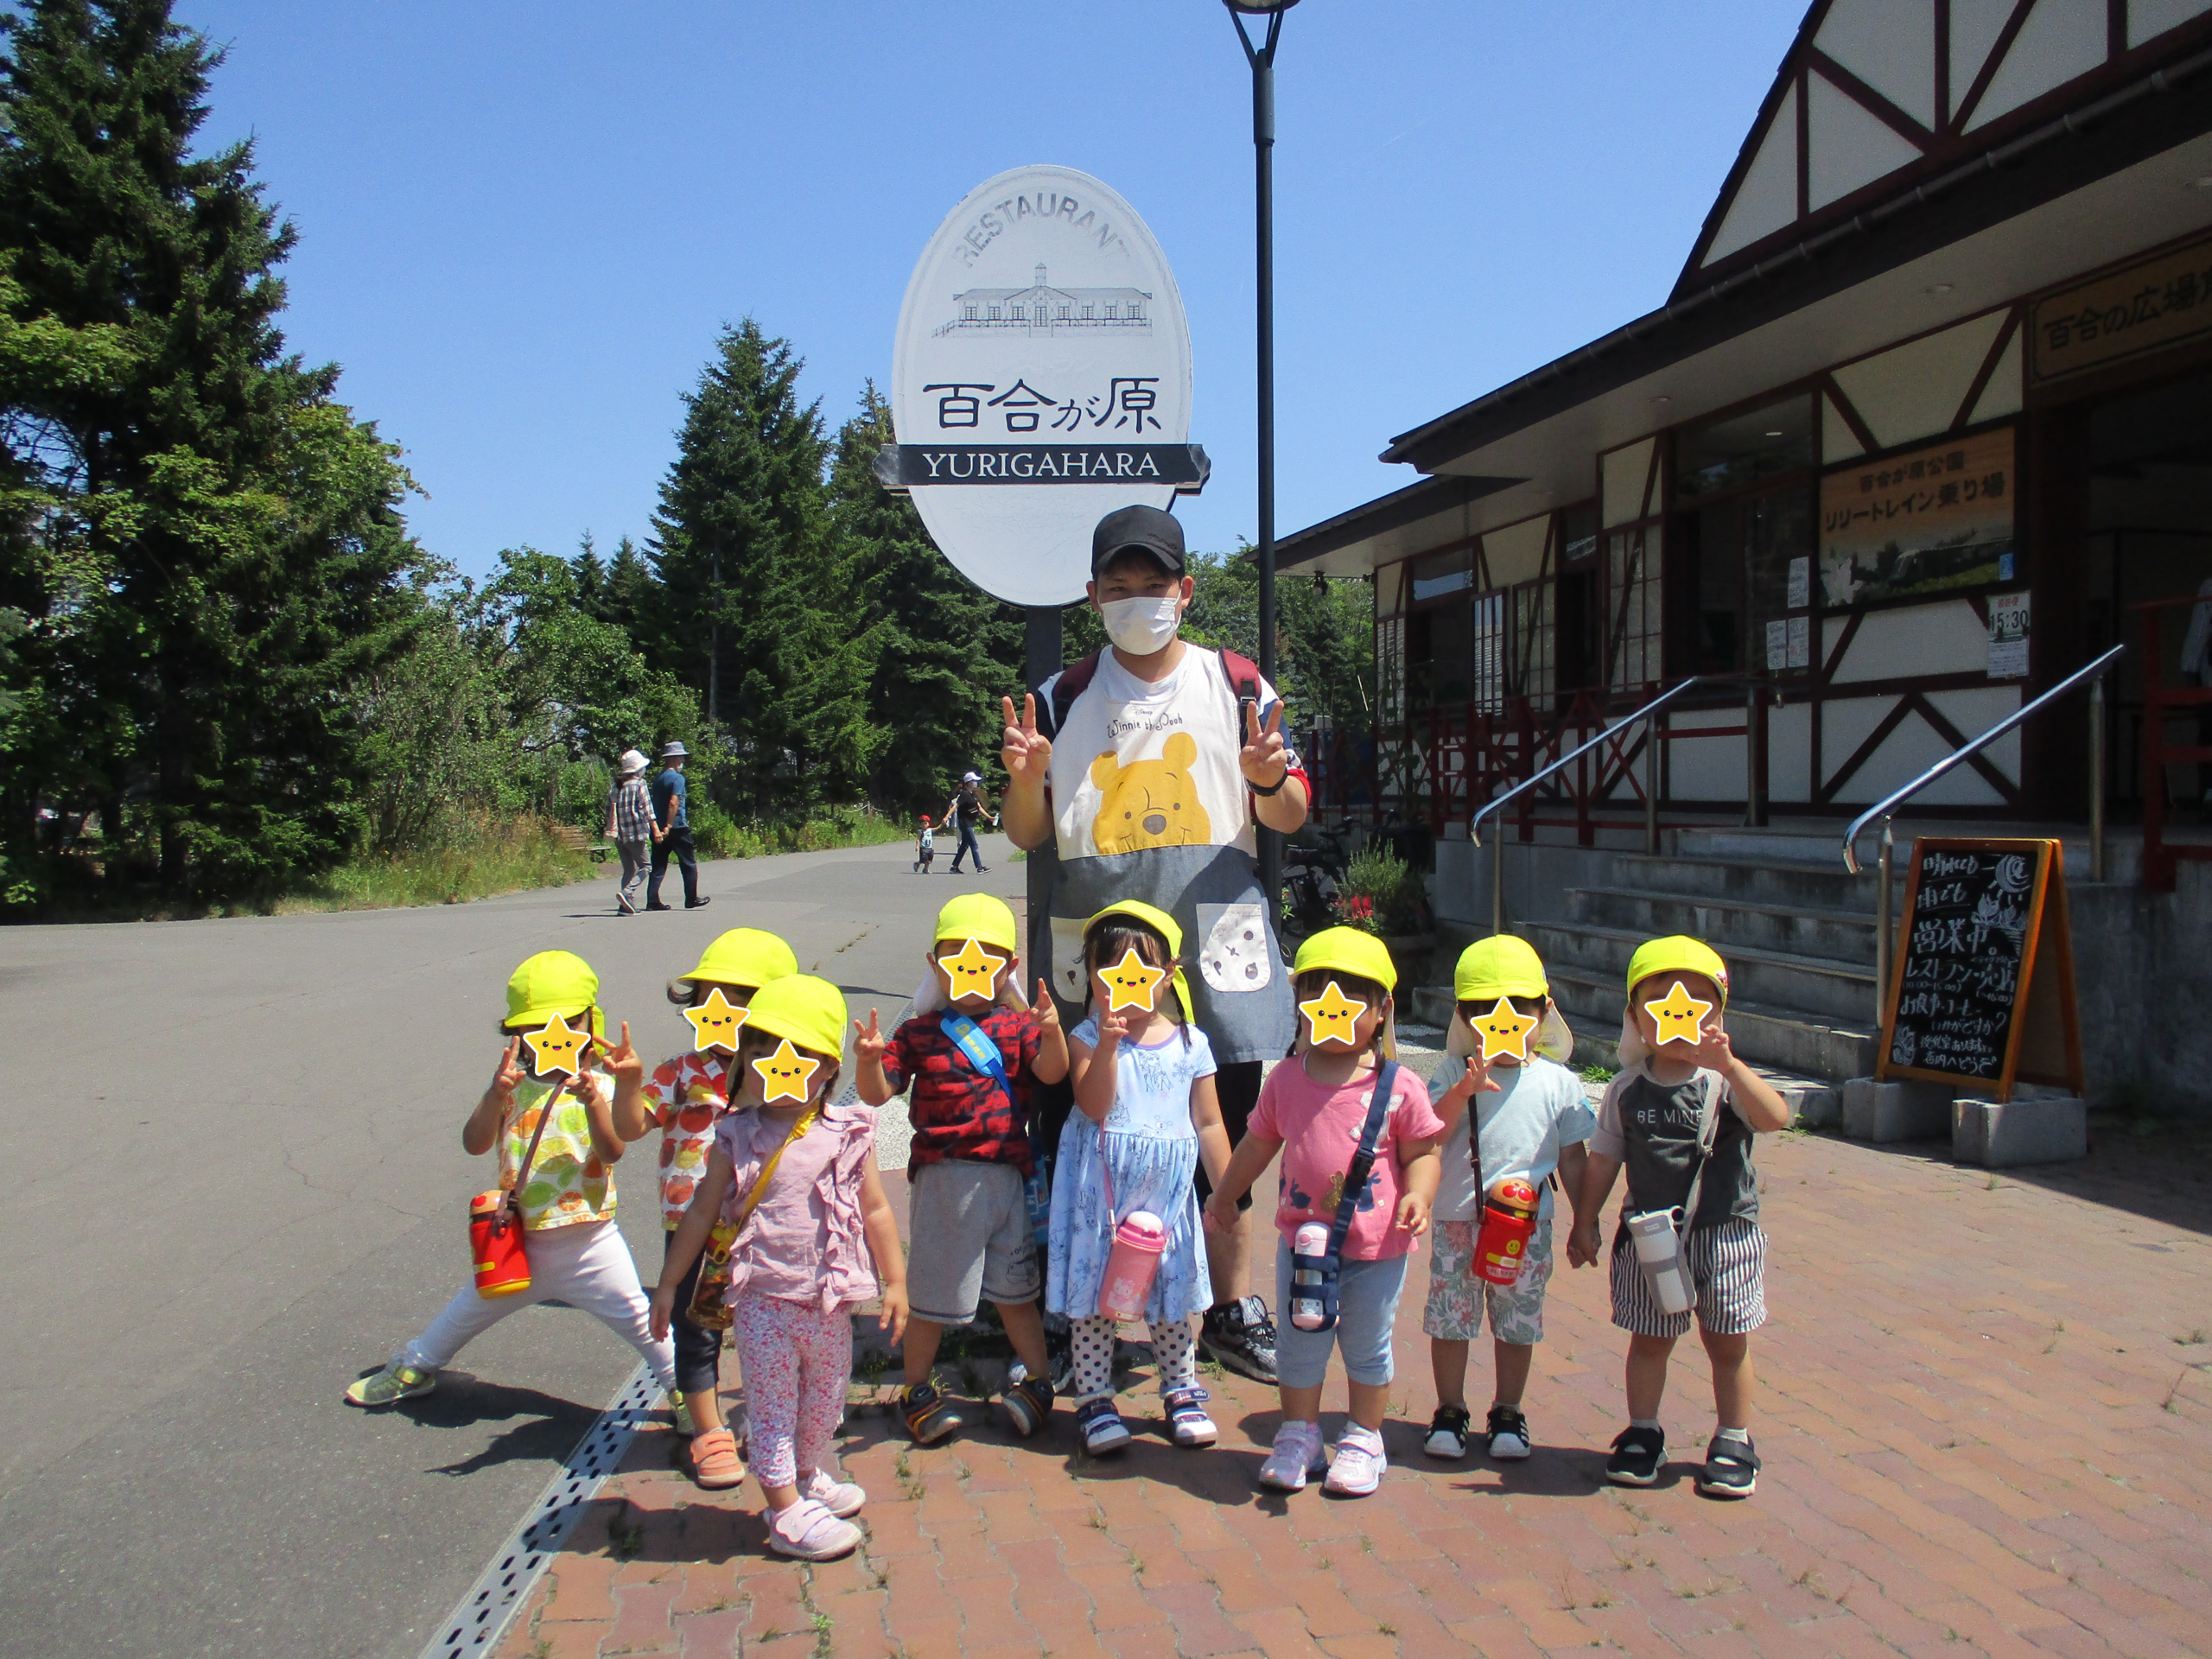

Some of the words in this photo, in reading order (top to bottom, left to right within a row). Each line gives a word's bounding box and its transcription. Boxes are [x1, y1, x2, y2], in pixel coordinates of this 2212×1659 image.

[951, 193, 1130, 268] RESTAURANT
[922, 378, 1161, 434] 百合が原
[922, 452, 1161, 478] YURIGAHARA
[1859, 450, 1964, 493] 百合が原公園
[1826, 471, 2005, 532] リリートレイン乗り場
[1990, 609, 2028, 632] 15:30
[1106, 719, 1141, 739] Winnie
[1155, 712, 1183, 731] Pooh
[1132, 708, 1154, 716] Disney
[1637, 1109, 1656, 1123] BE
